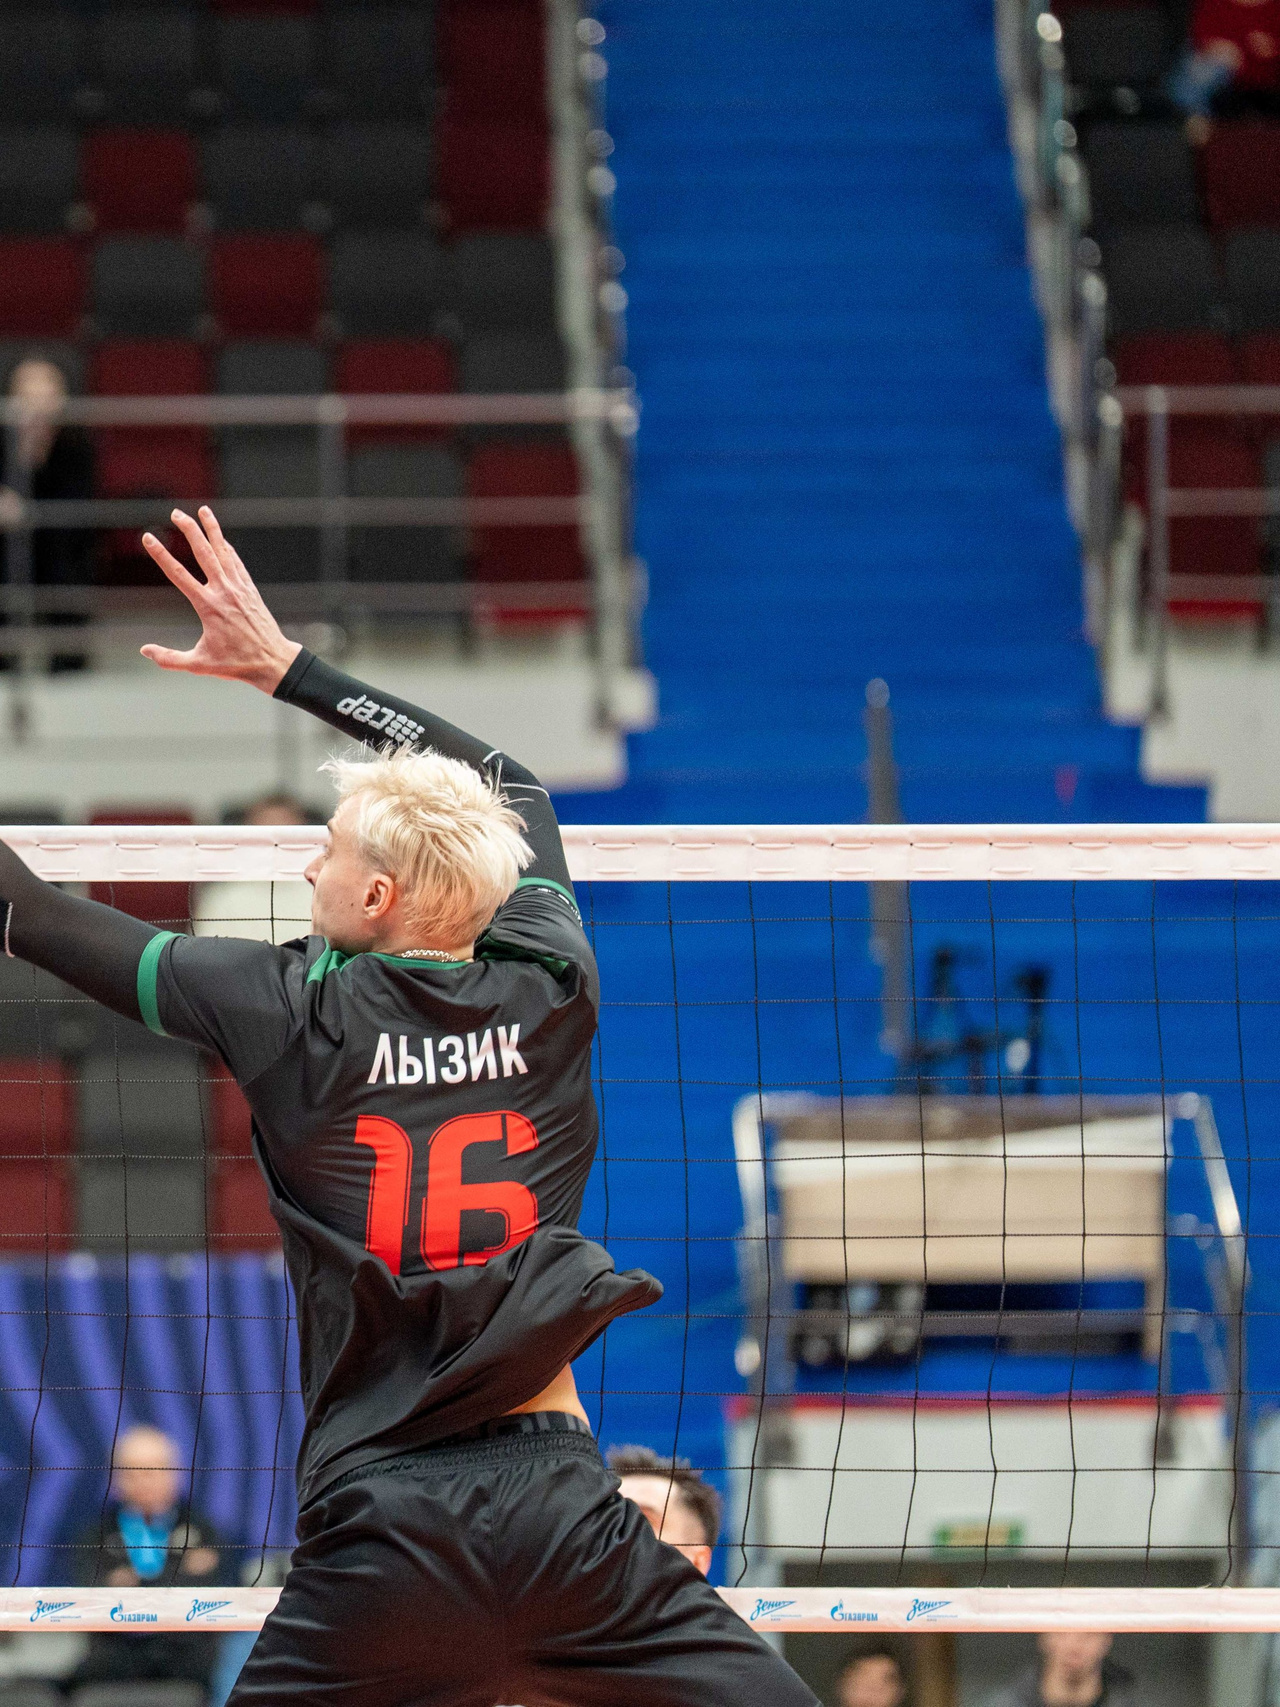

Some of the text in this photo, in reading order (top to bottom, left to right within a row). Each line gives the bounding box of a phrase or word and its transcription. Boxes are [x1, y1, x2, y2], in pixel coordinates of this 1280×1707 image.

[337, 694, 396, 730] cep
[367, 1023, 529, 1085] ЛЫЗИК
[354, 1110, 539, 1276] 16
